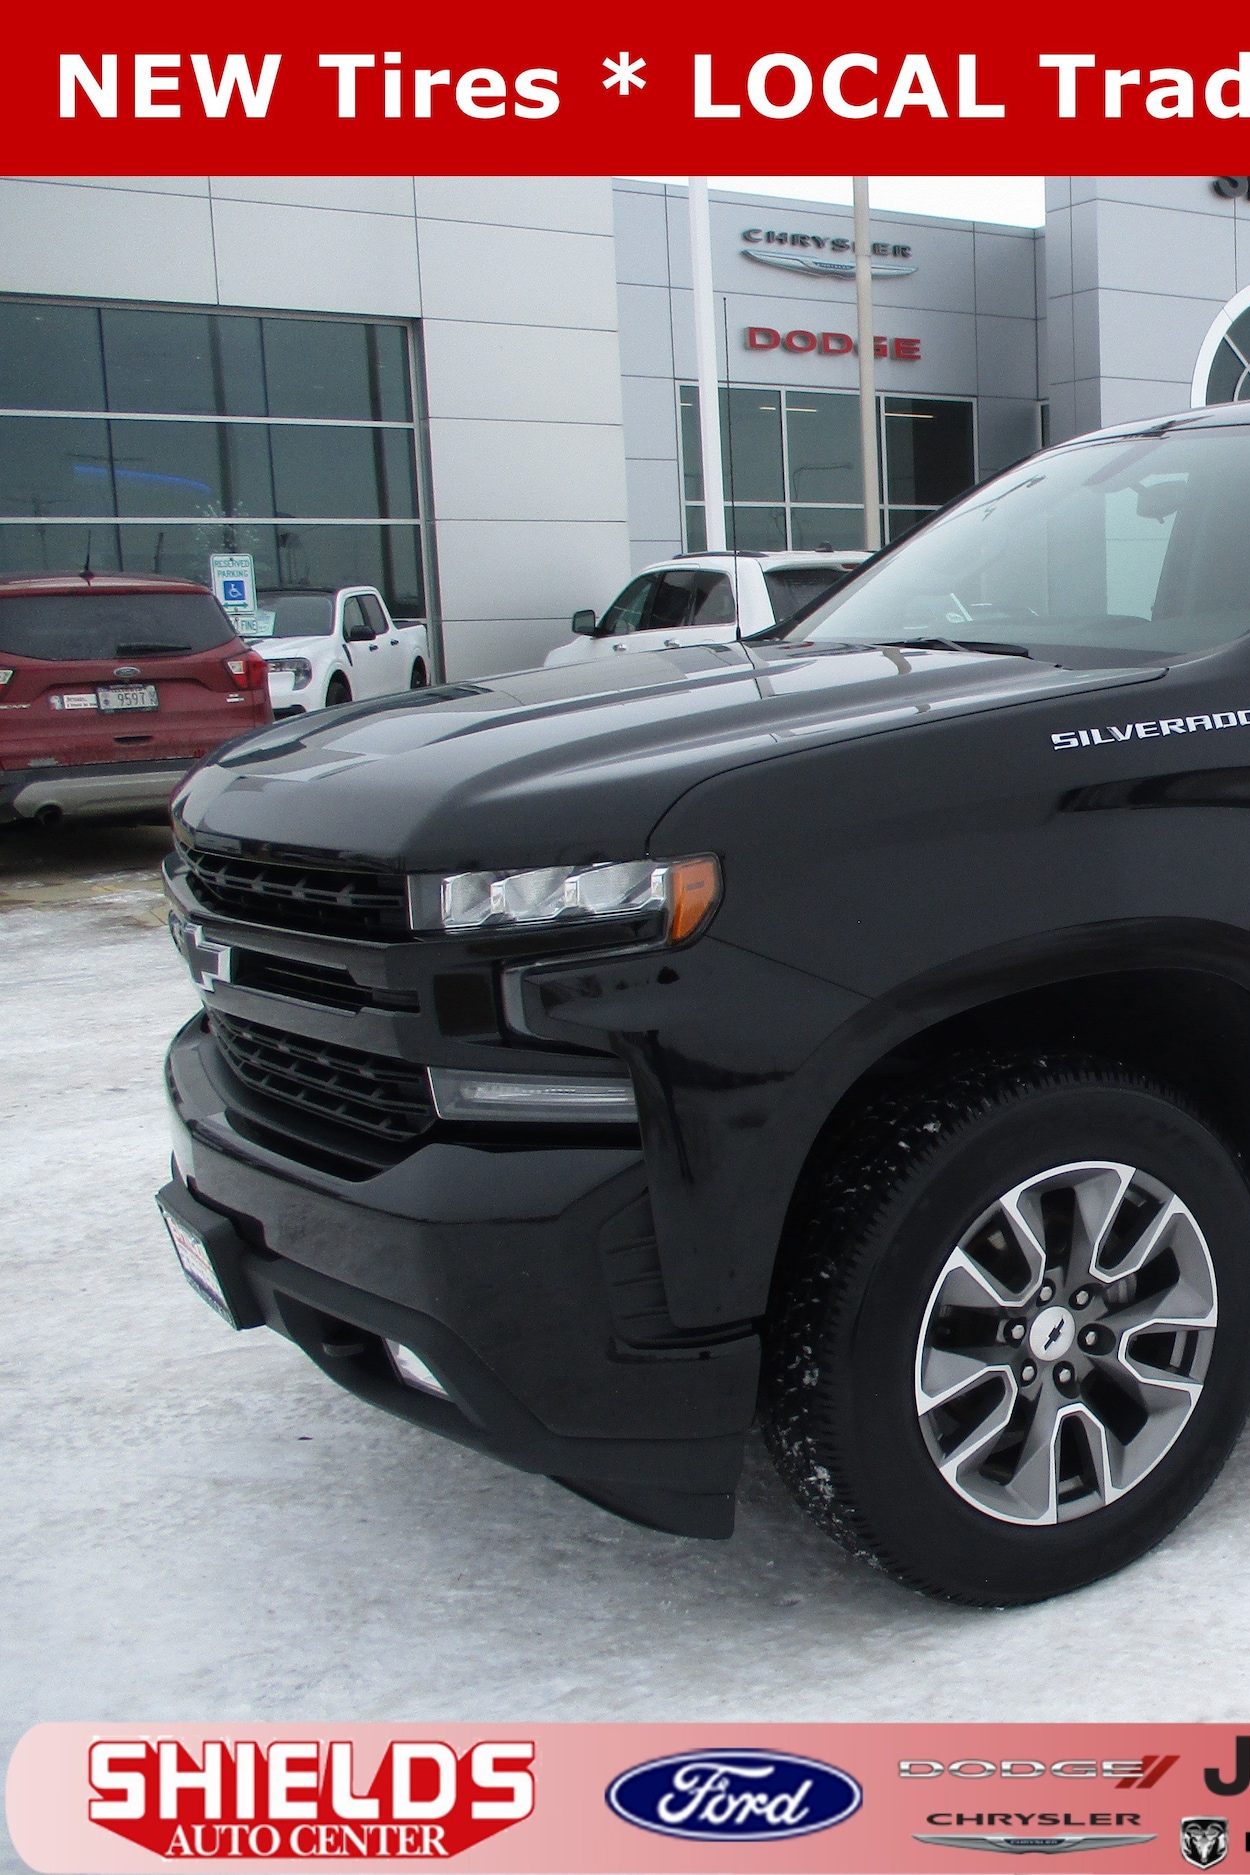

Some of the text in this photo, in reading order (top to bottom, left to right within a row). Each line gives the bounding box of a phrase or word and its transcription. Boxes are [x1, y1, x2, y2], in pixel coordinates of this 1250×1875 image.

[742, 228, 912, 259] CHRYSER
[214, 559, 250, 568] RESERVED
[217, 569, 249, 578] PARKING
[241, 620, 257, 630] FINE
[117, 692, 146, 706] 9597
